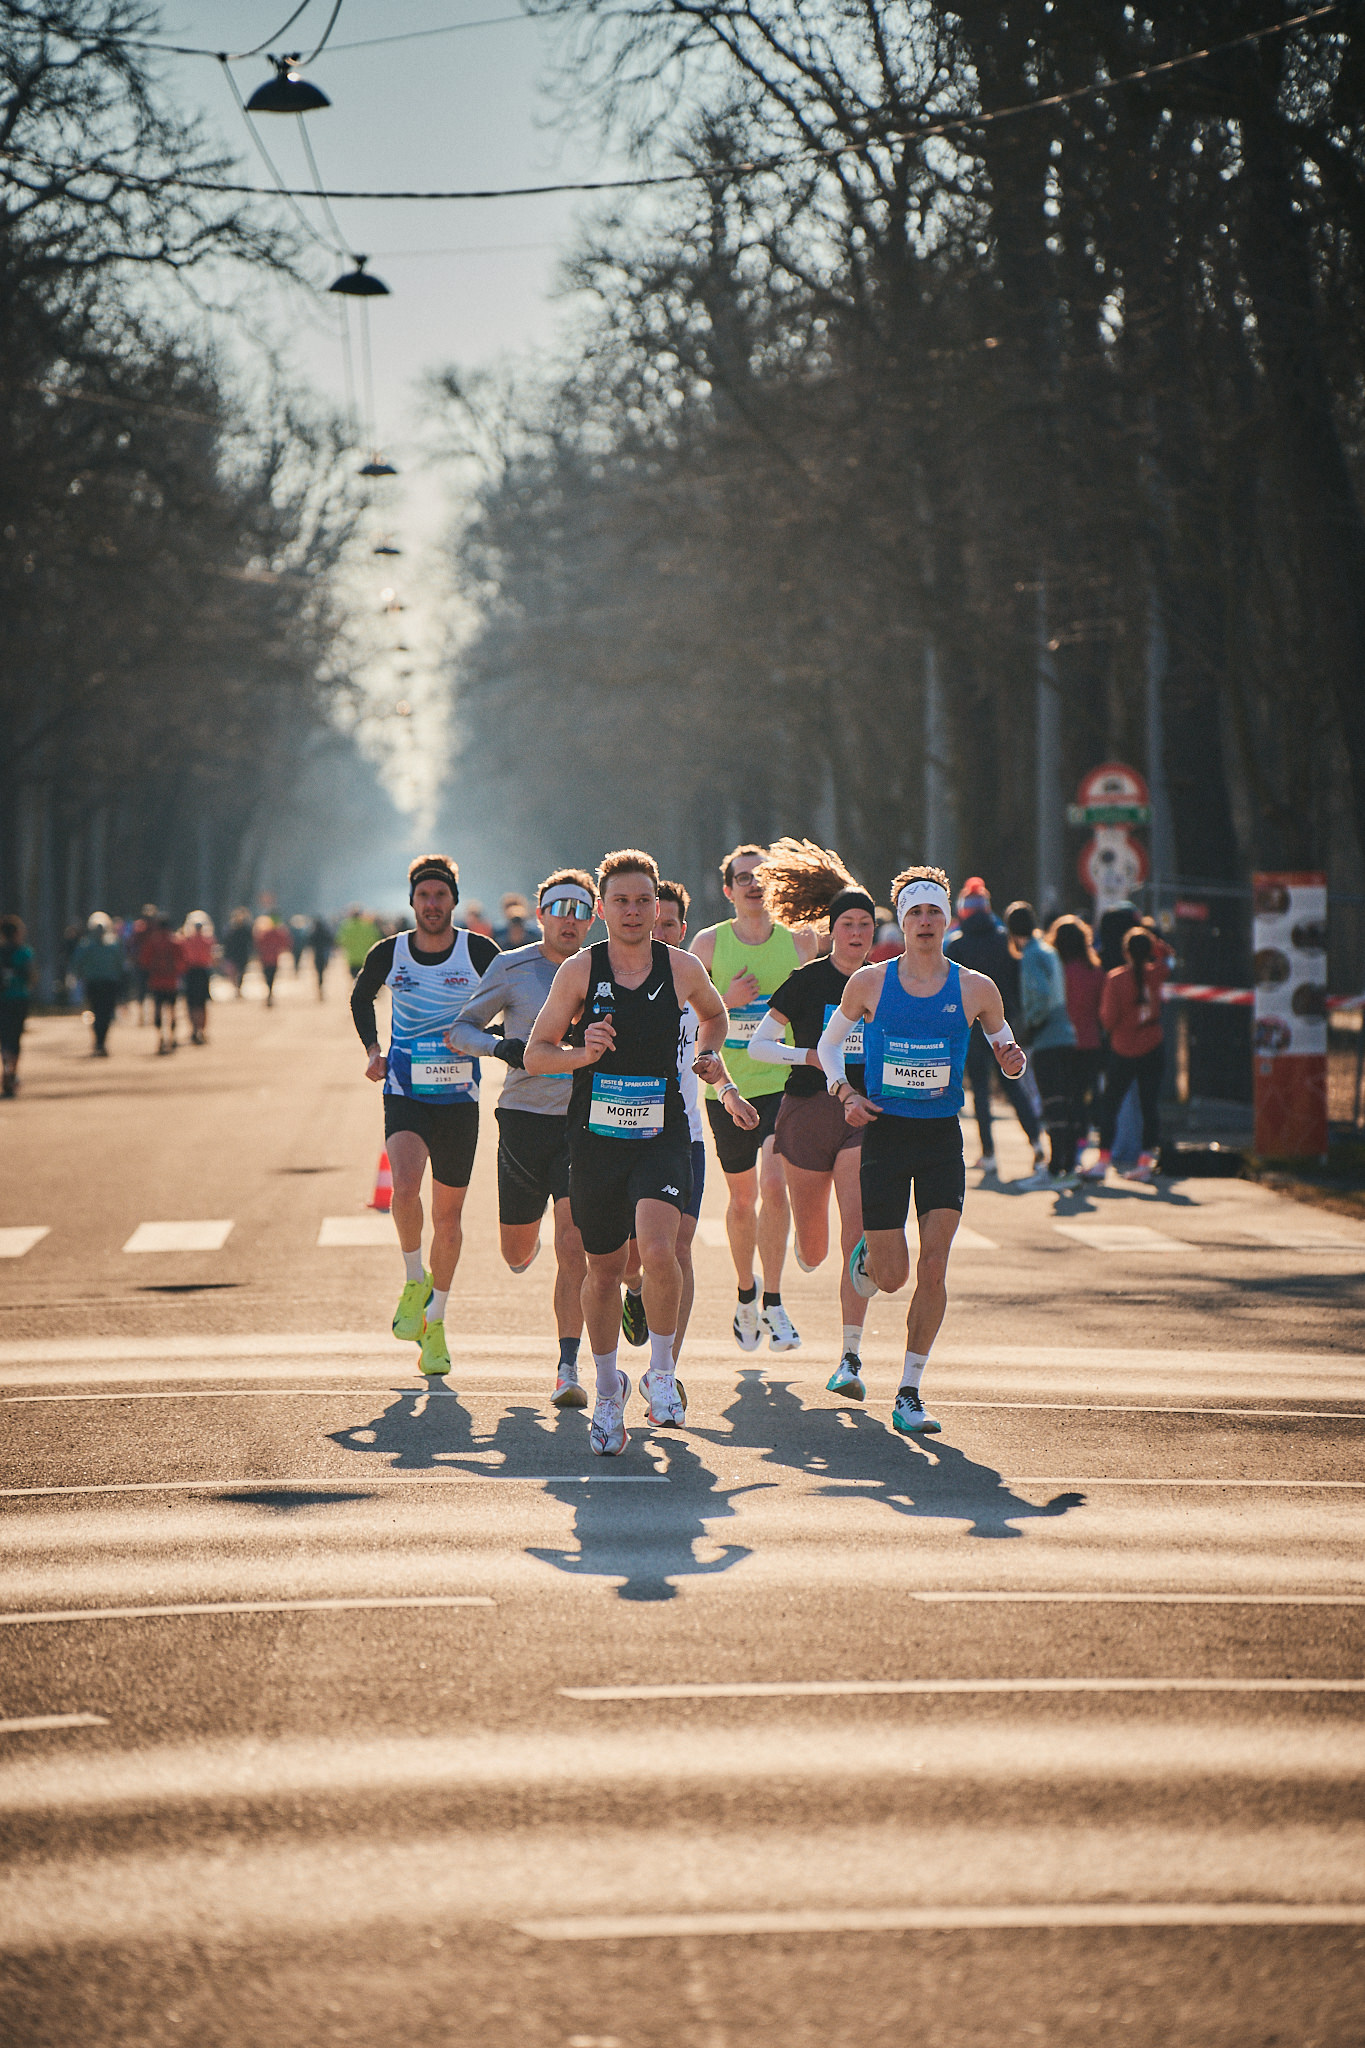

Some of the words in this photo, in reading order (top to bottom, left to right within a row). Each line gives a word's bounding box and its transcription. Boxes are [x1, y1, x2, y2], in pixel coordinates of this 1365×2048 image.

[425, 1066, 460, 1074] DANIEL
[895, 1067, 938, 1078] MARCEL
[607, 1105, 650, 1117] MORITZ
